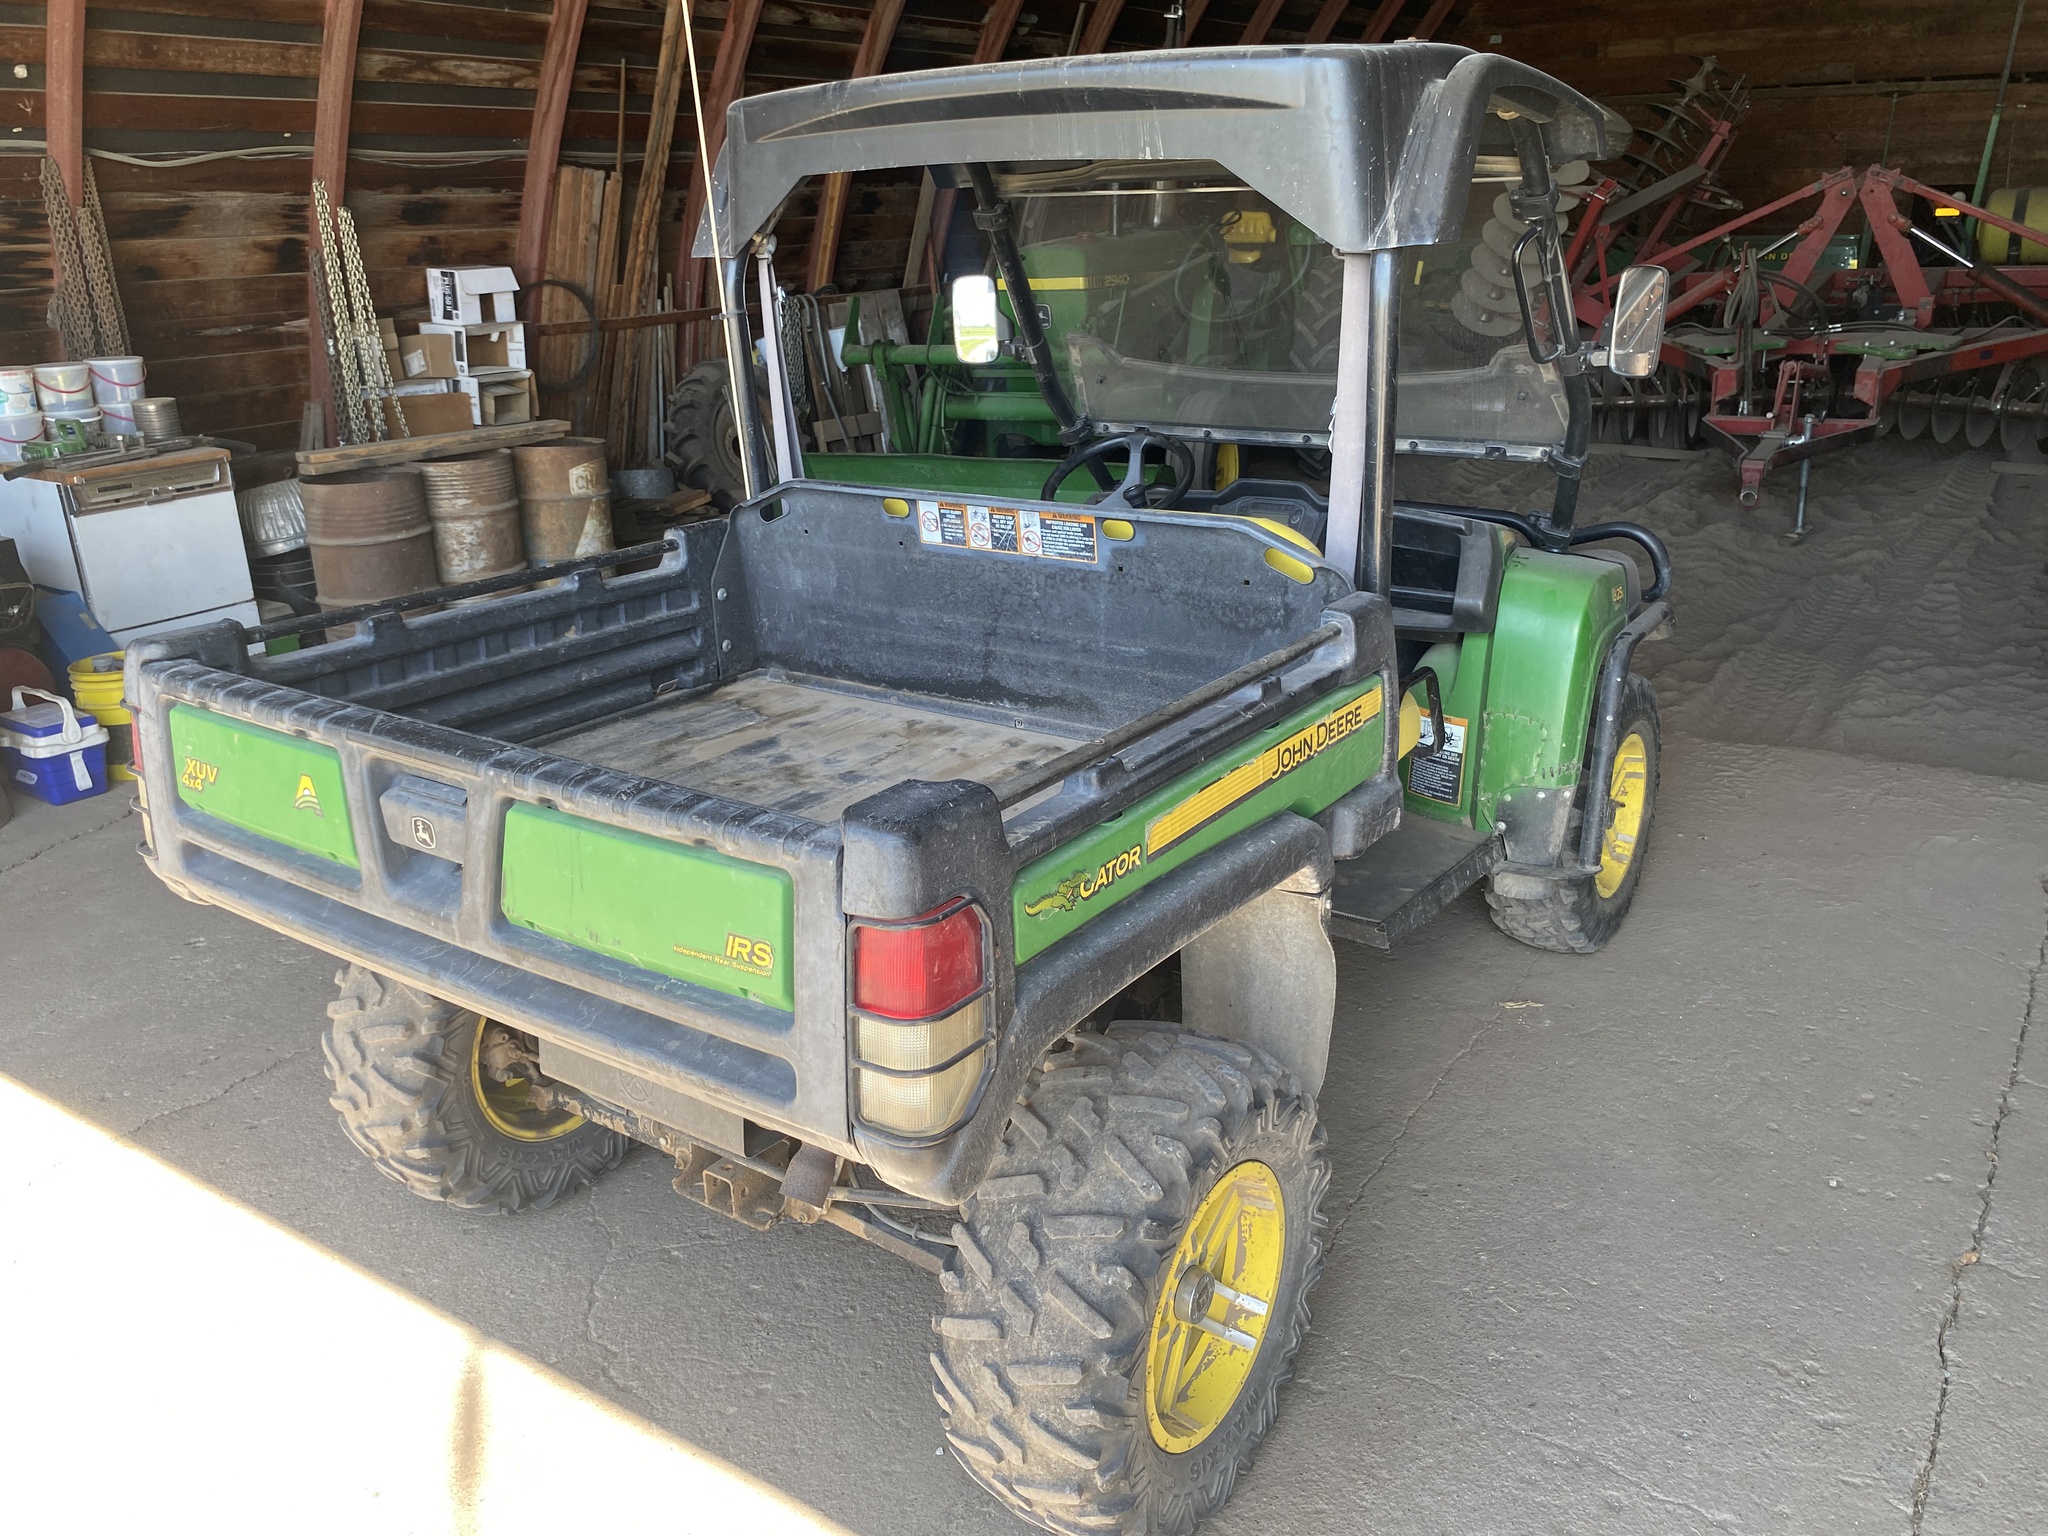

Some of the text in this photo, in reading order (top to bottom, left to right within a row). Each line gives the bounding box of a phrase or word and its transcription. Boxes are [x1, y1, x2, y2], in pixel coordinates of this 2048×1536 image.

[1270, 704, 1363, 780] JOHN DEERE
[182, 774, 203, 791] 4x4
[186, 758, 218, 783] XUV
[1078, 844, 1143, 901] GATOR
[673, 945, 713, 962] Independent
[714, 956, 730, 966] Rear
[727, 935, 772, 967] IRS
[498, 1138, 585, 1164] MAXXIS
[1189, 1386, 1262, 1483] MAXXIS
